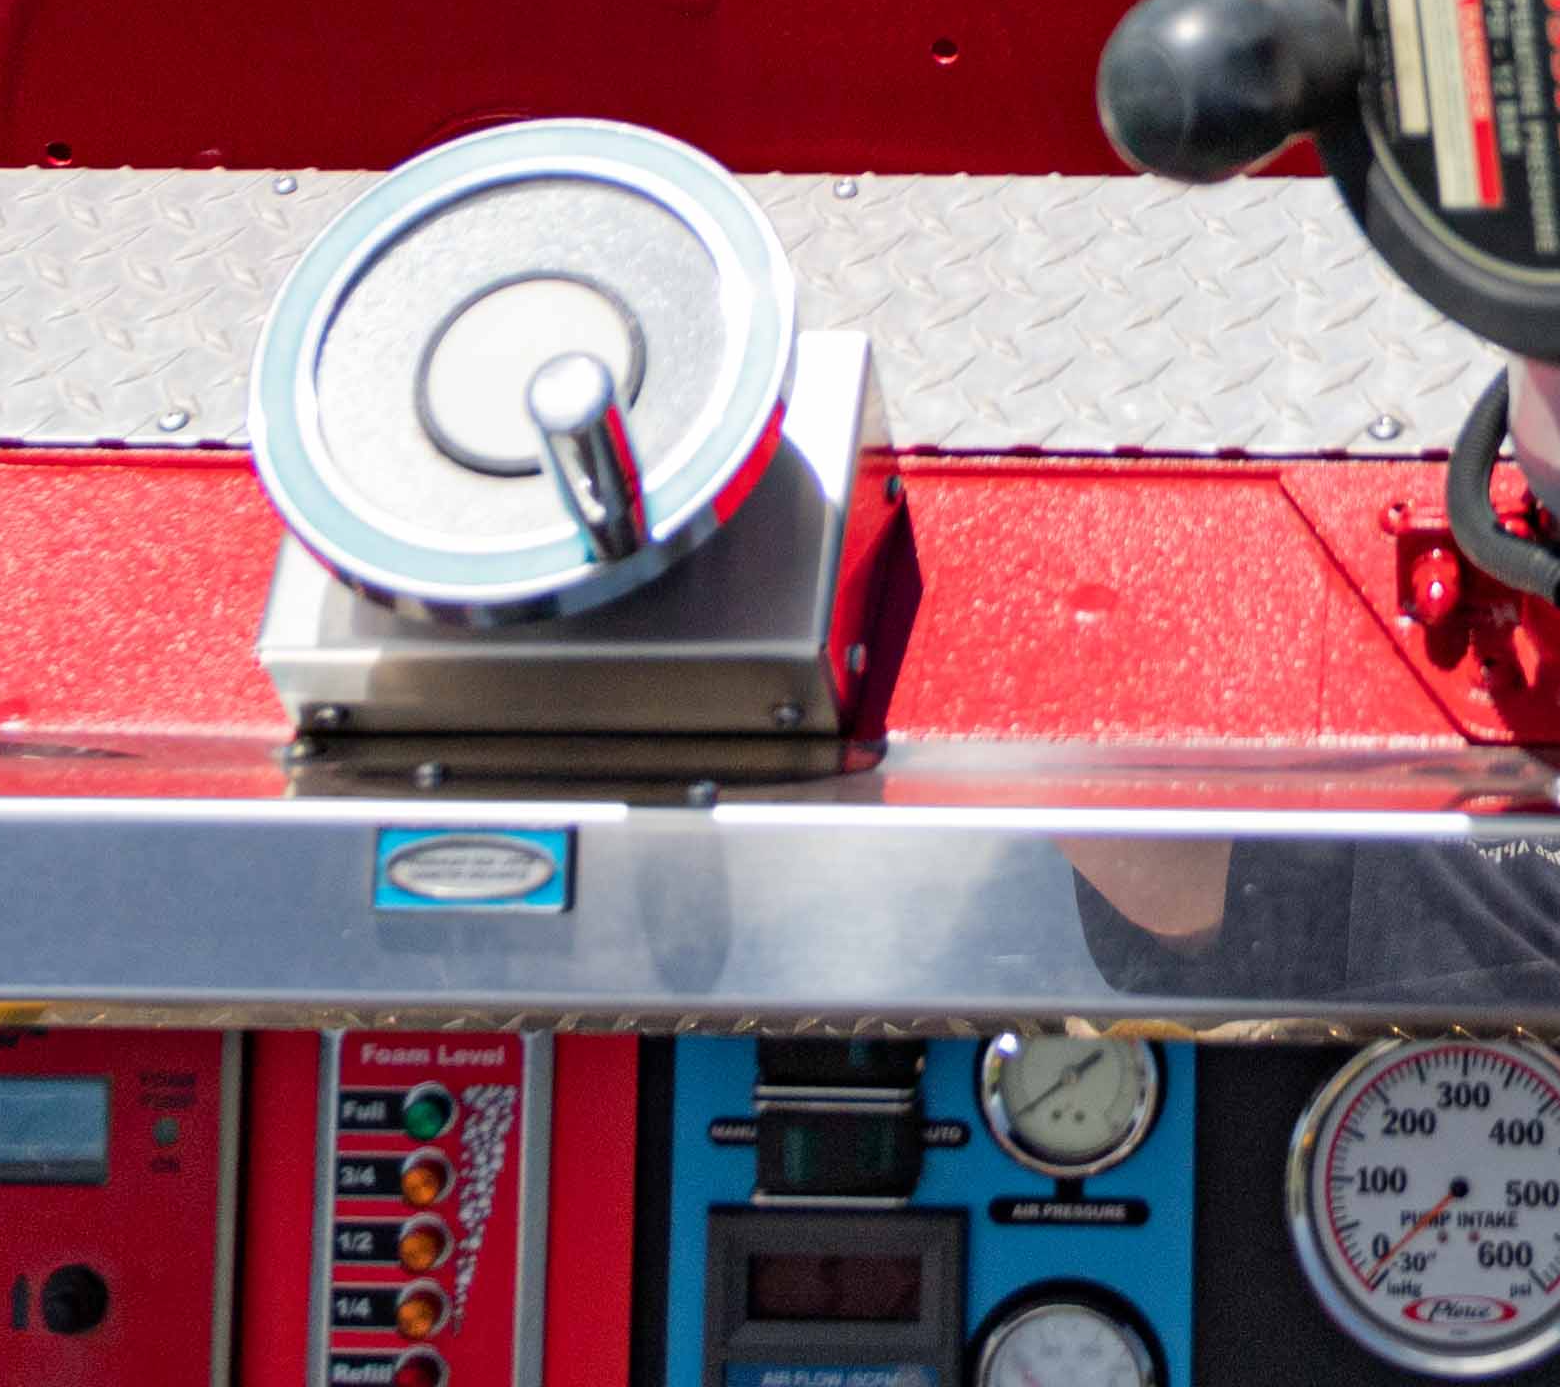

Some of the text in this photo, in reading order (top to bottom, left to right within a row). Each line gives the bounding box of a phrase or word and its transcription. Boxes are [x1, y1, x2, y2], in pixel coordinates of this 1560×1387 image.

[1496, 100, 1521, 156] BAR
[1524, 119, 1560, 253] PRESSURE
[360, 1043, 506, 1067] Foam Level
[1436, 1081, 1491, 1109] 300
[343, 1099, 386, 1123] Full
[1381, 1109, 1436, 1138] 200
[1488, 1119, 1545, 1147] 400
[340, 1164, 377, 1188] 3/4
[1356, 1166, 1407, 1194] 100
[1505, 1180, 1560, 1208] 500
[1011, 1203, 1127, 1220] AIR PRESSURE
[1399, 1210, 1519, 1229] PUMP INTAKE
[340, 1231, 374, 1254] 1/2
[1371, 1232, 1389, 1261] 0
[1477, 1241, 1534, 1269] 600
[1386, 1282, 1423, 1299] inHg
[1509, 1281, 1533, 1299] psi
[337, 1296, 371, 1318] 1/4
[1426, 1299, 1492, 1323] Pierce
[333, 1363, 395, 1385] Refill
[793, 1371, 841, 1387] FLOW
